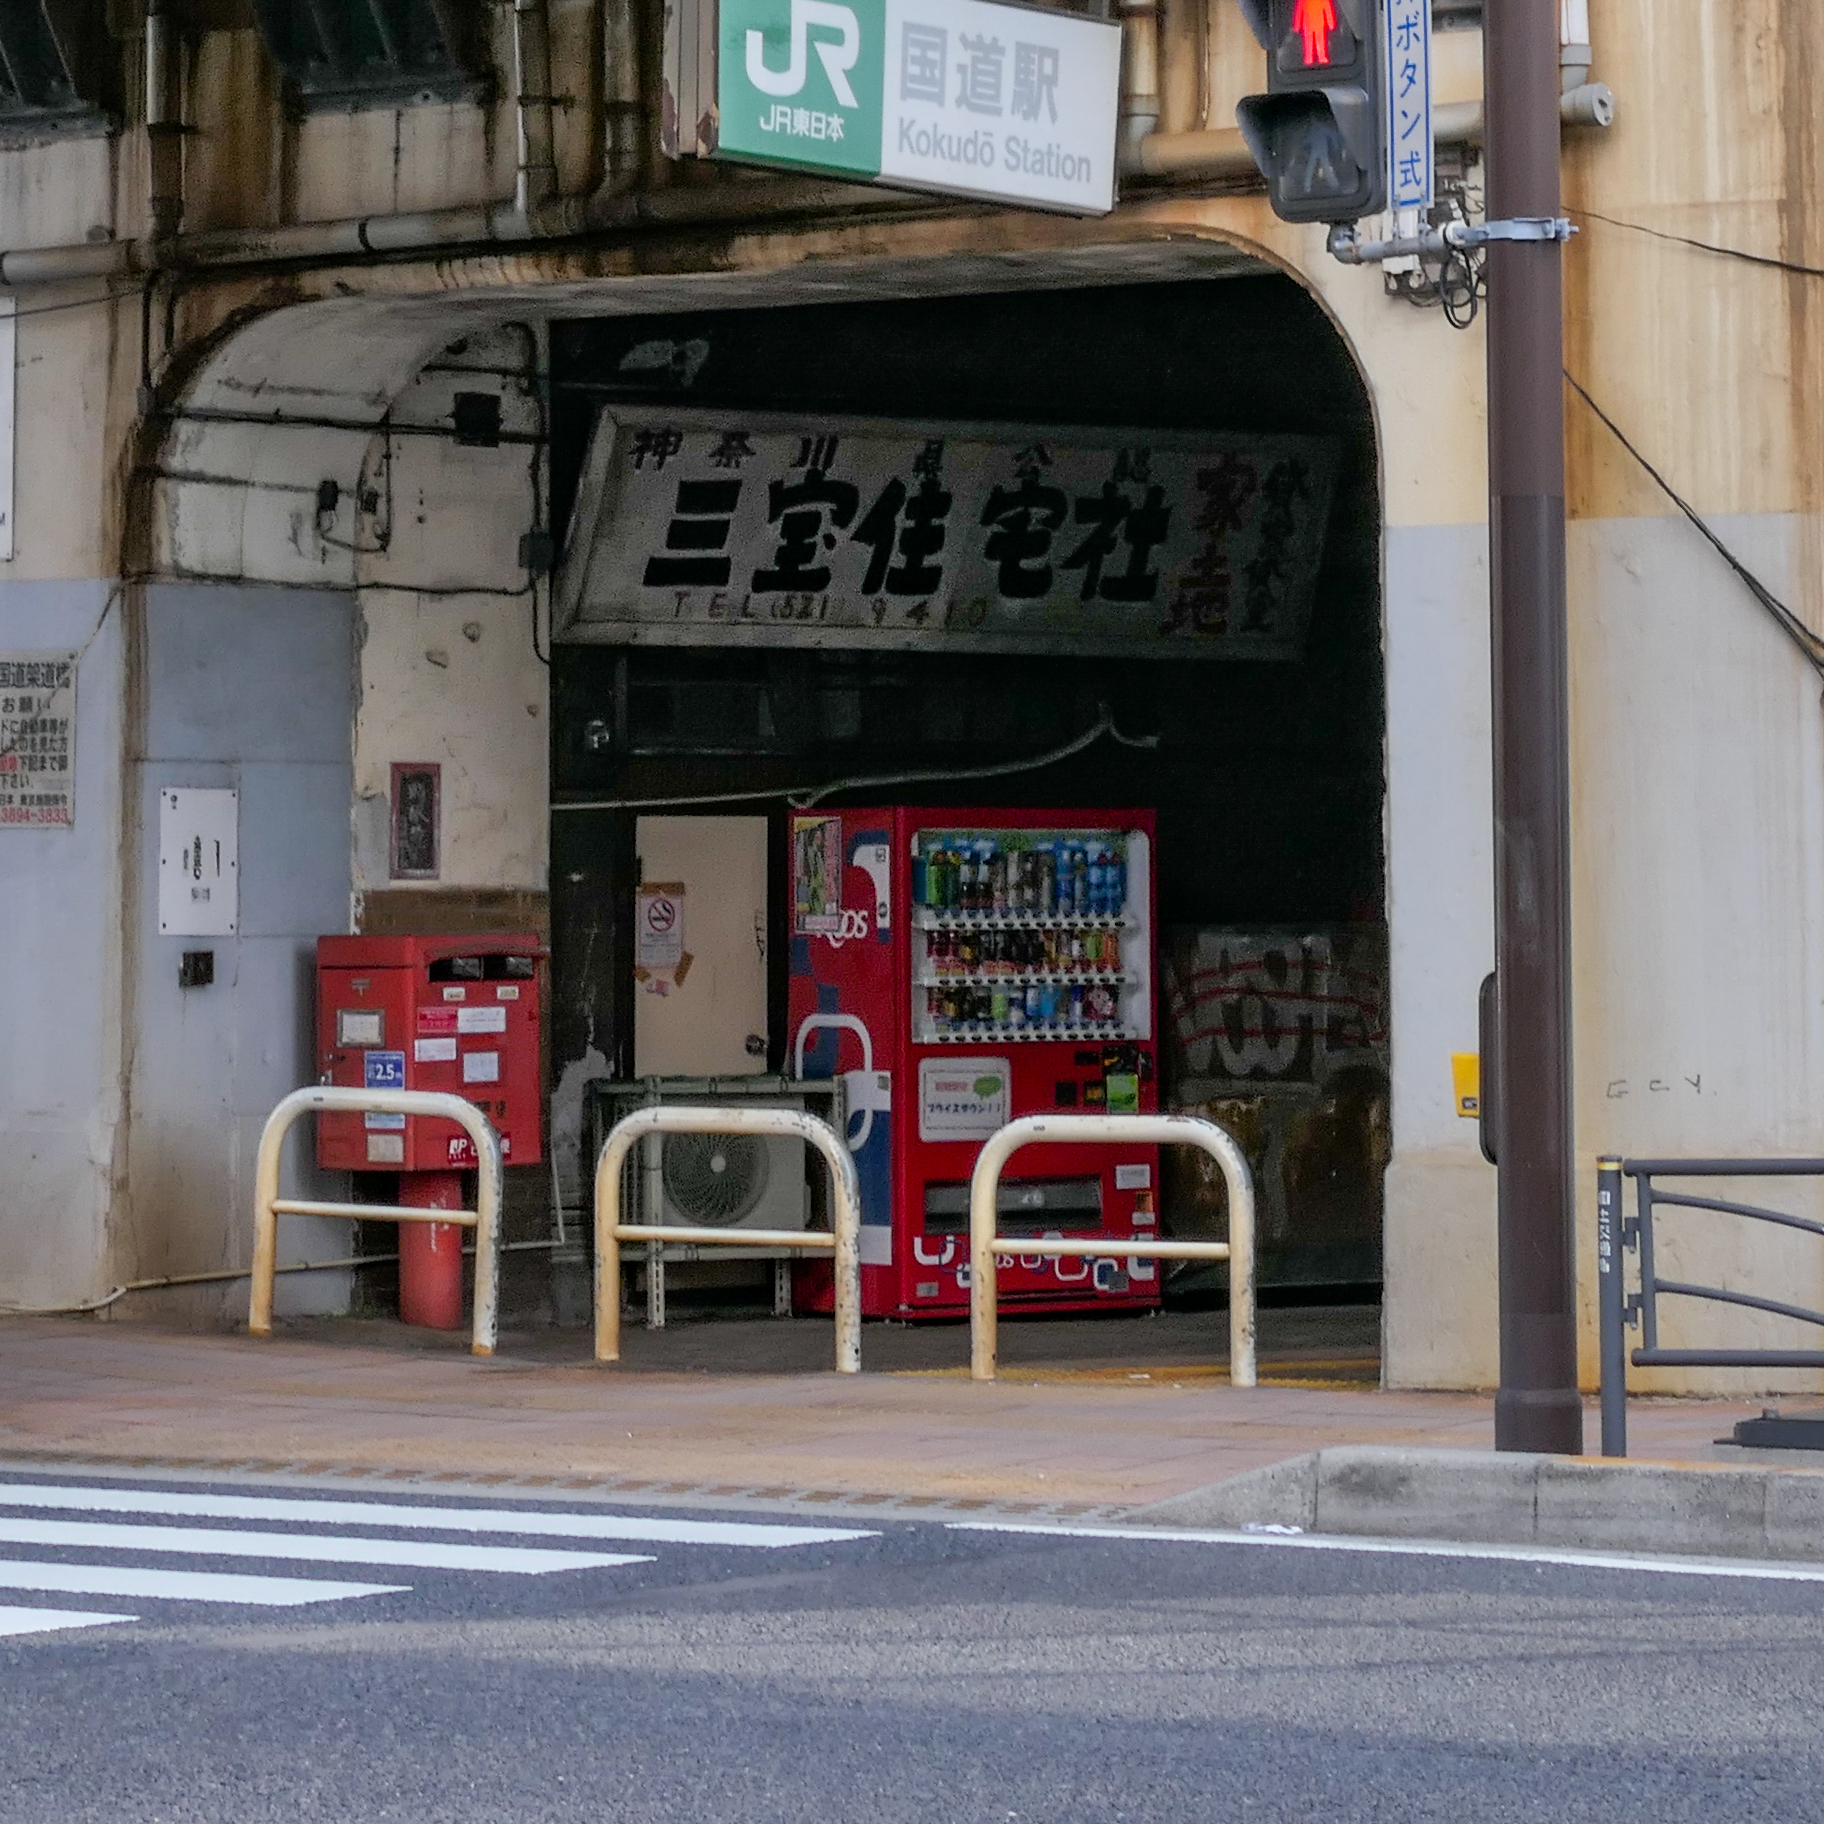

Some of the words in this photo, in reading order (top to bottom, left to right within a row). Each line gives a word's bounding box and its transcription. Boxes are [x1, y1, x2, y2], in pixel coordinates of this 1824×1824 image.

[898, 21, 1060, 126] 国道駅
[759, 102, 846, 142] JR東日本
[896, 115, 996, 168] Kokudō
[1004, 134, 1092, 184] Station
[642, 468, 1173, 601] 三宝住宅社
[674, 591, 756, 618] TEL
